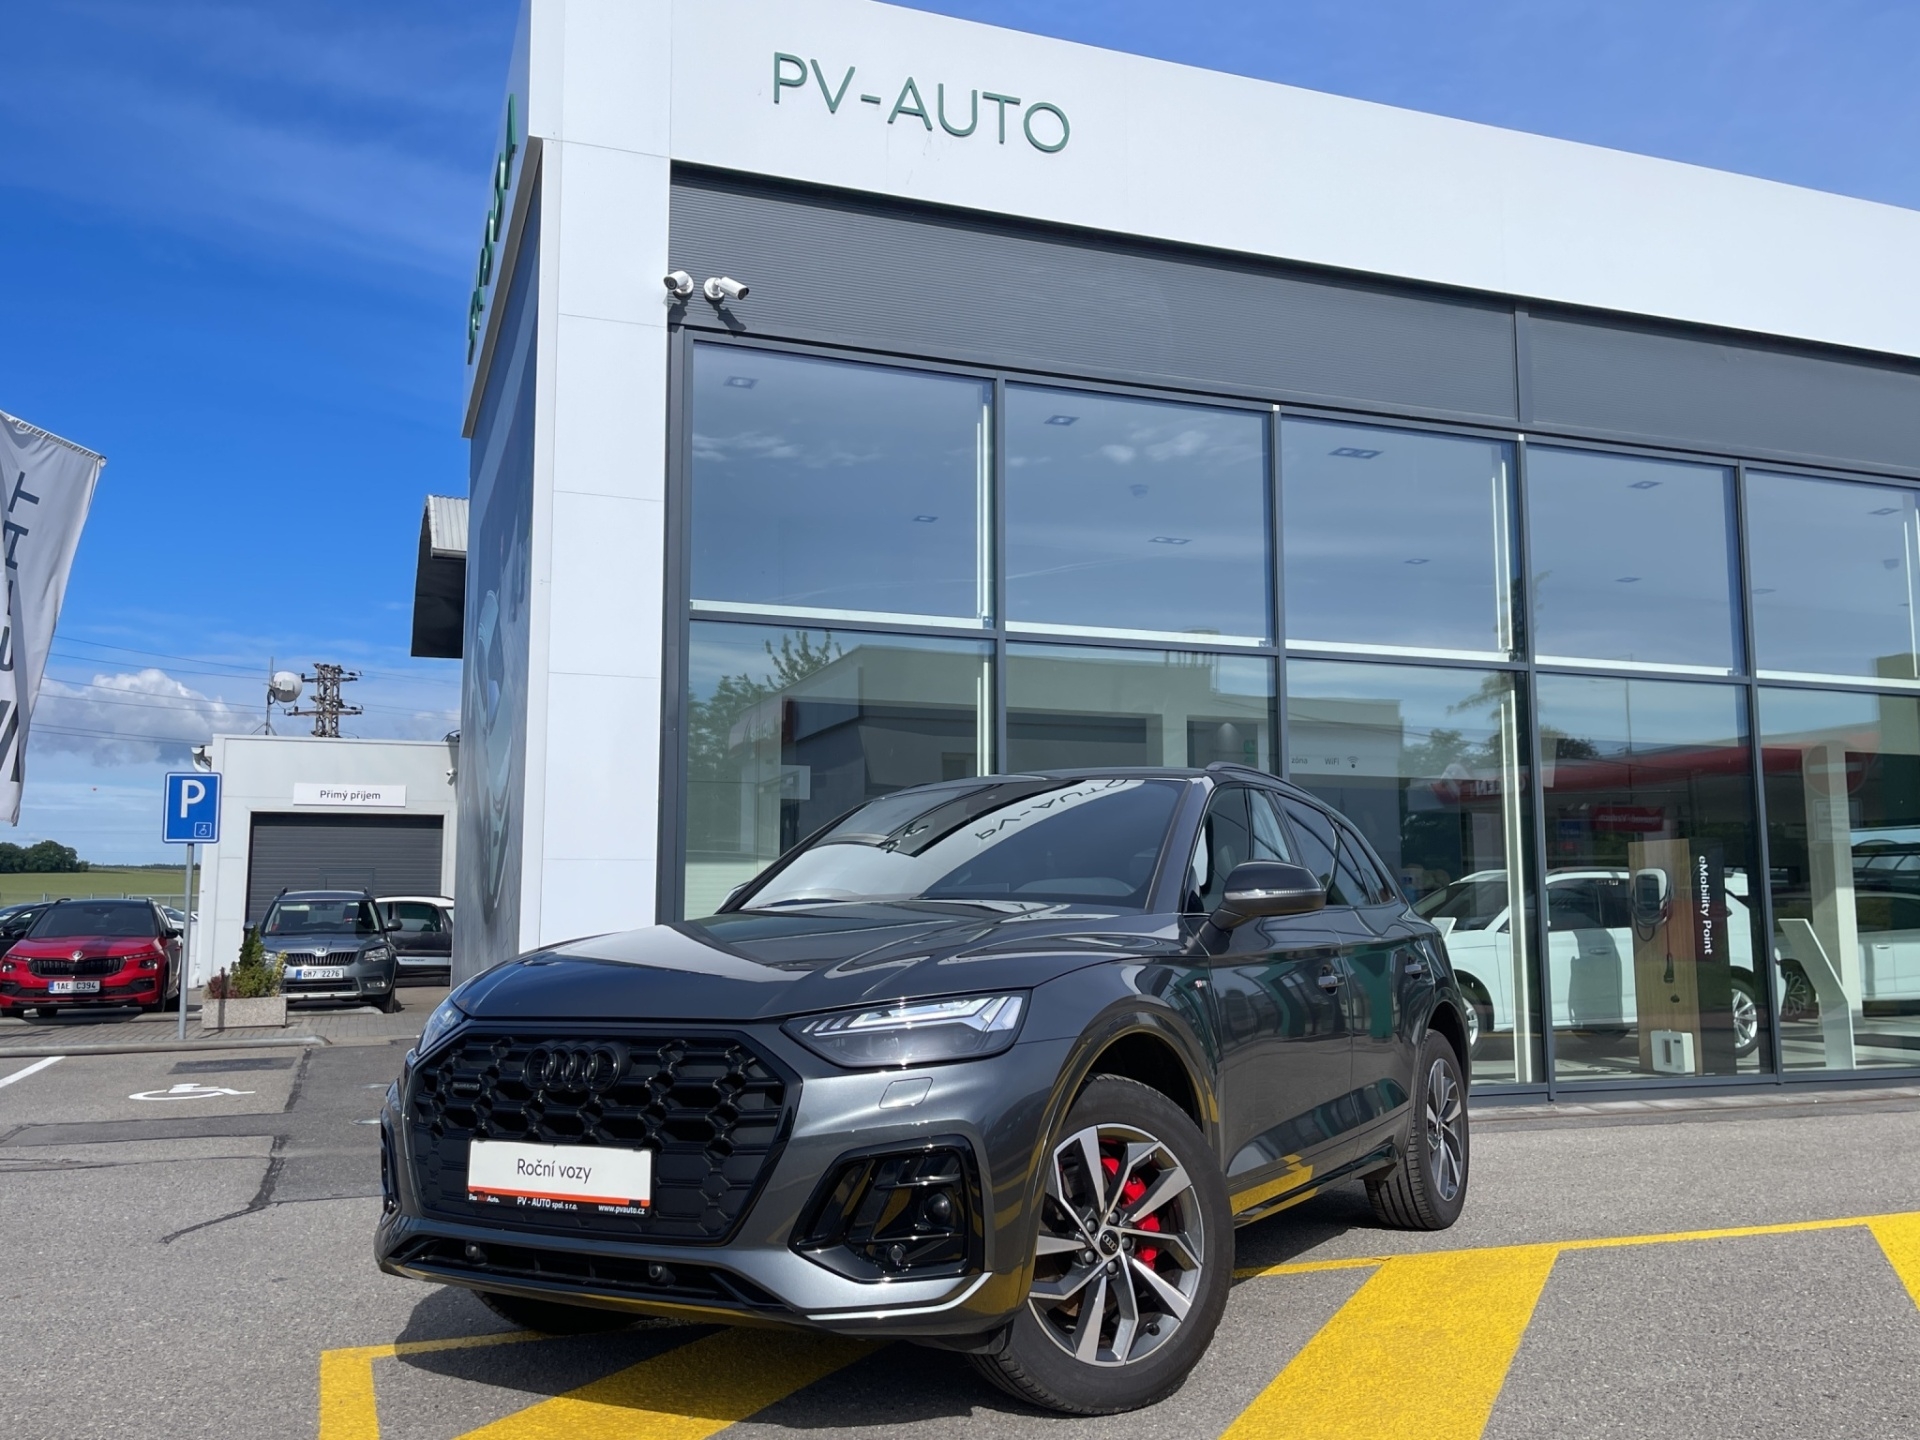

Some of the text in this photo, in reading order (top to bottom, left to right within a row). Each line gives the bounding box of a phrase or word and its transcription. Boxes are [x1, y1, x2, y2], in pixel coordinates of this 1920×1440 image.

[773, 51, 1070, 154] PV-AUTO
[180, 779, 206, 818] P
[319, 789, 348, 801] Přímý
[1698, 855, 1713, 955] eMobility Point
[321, 969, 340, 978] 2276
[55, 981, 96, 990] 1AE C394
[517, 1158, 592, 1184] Roční vozy
[516, 1196, 527, 1206] PV
[531, 1198, 551, 1208] AUTO
[598, 1204, 646, 1215] www.pvauto.cz
